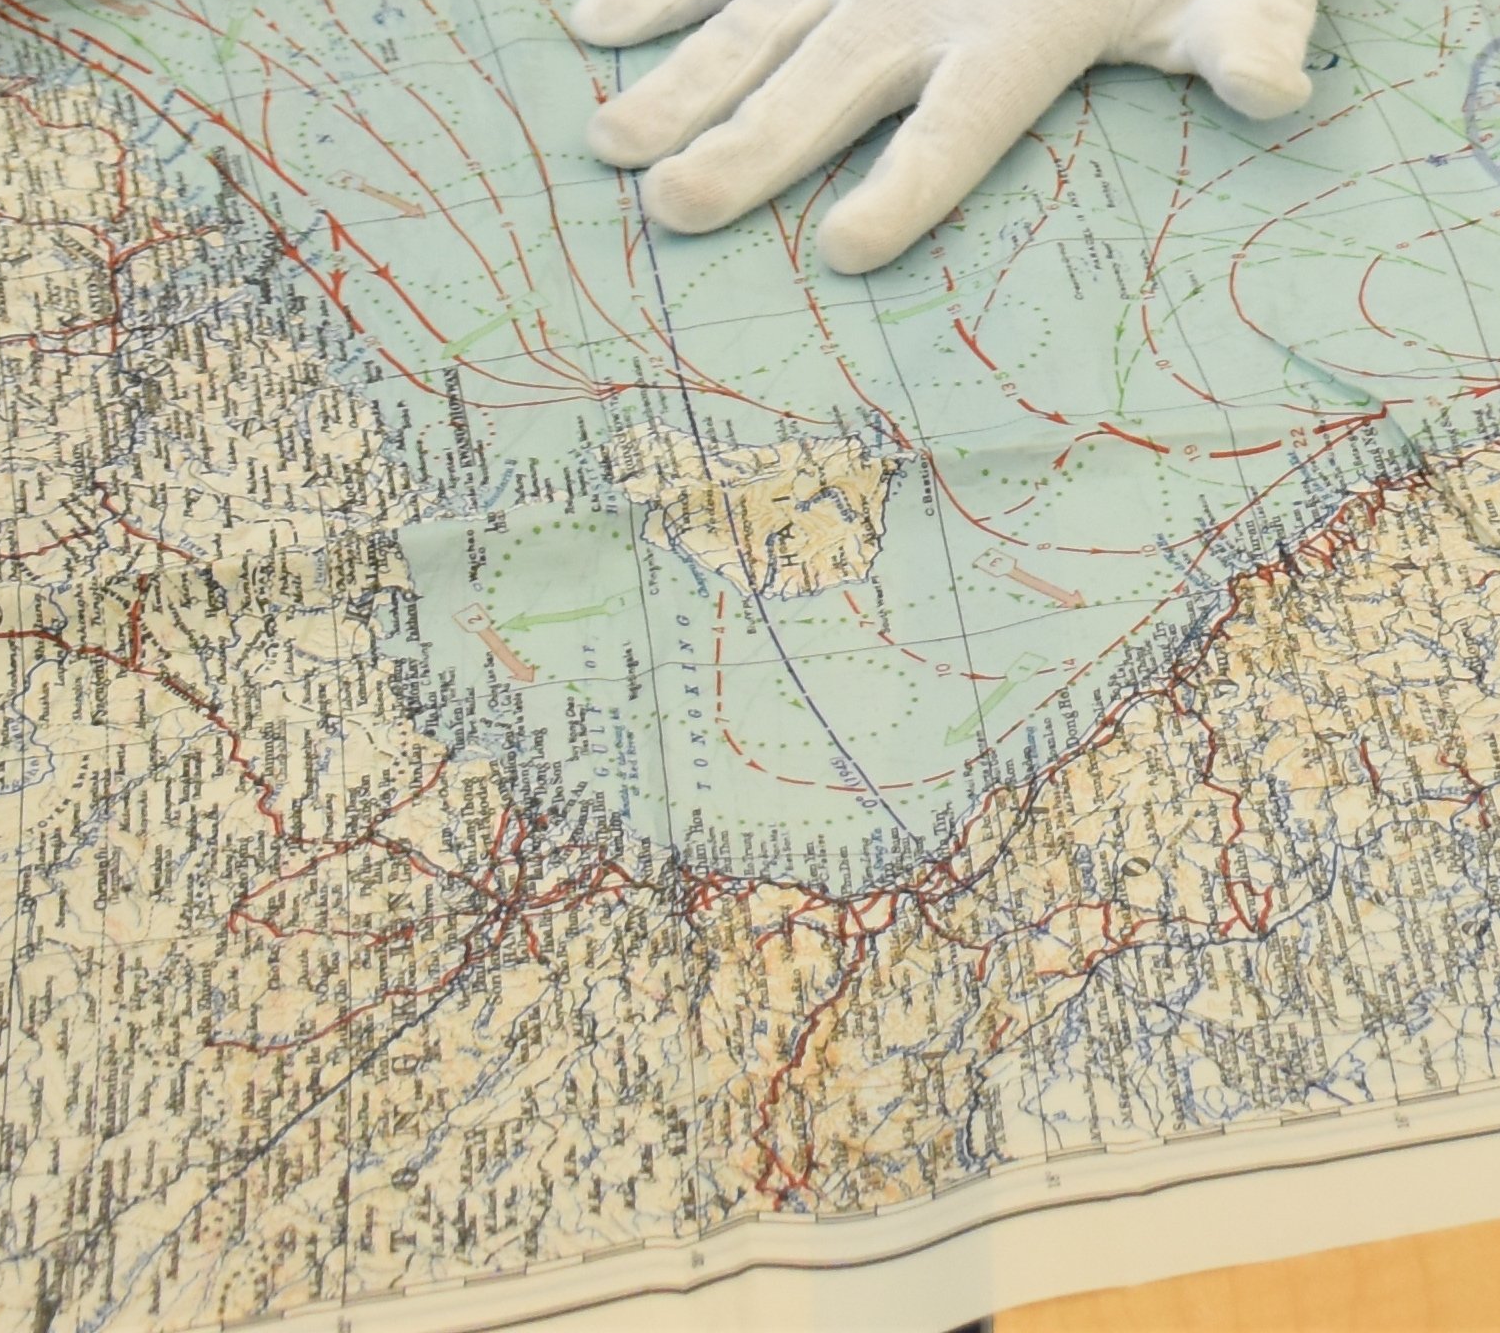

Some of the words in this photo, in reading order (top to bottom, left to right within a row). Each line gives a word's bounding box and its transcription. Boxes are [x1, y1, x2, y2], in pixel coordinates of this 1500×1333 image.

[1046, 203, 1060, 212] 6
[631, 293, 644, 301] 7
[820, 342, 836, 356] 12
[649, 355, 665, 370] 12
[1155, 358, 1171, 372] 10
[1001, 382, 1018, 398] 13
[1289, 426, 1307, 448] 22
[1183, 443, 1200, 463] 19
[917, 452, 934, 504] Bastion
[1036, 542, 1052, 551] 8
[1139, 544, 1157, 559] 10
[468, 614, 482, 625] 2
[712, 626, 726, 635] 4
[584, 644, 598, 669] OF
[935, 663, 951, 678] 10
[1061, 657, 1077, 673] 14
[675, 614, 712, 791] TONGKING
[714, 716, 729, 725] 7
[1062, 710, 1081, 750] Dong
[589, 702, 610, 778] GULF
[550, 760, 564, 784] Son
[829, 755, 860, 787] (1945)
[360, 774, 372, 796] Son
[552, 786, 566, 803] Do
[856, 794, 878, 809] 0°
